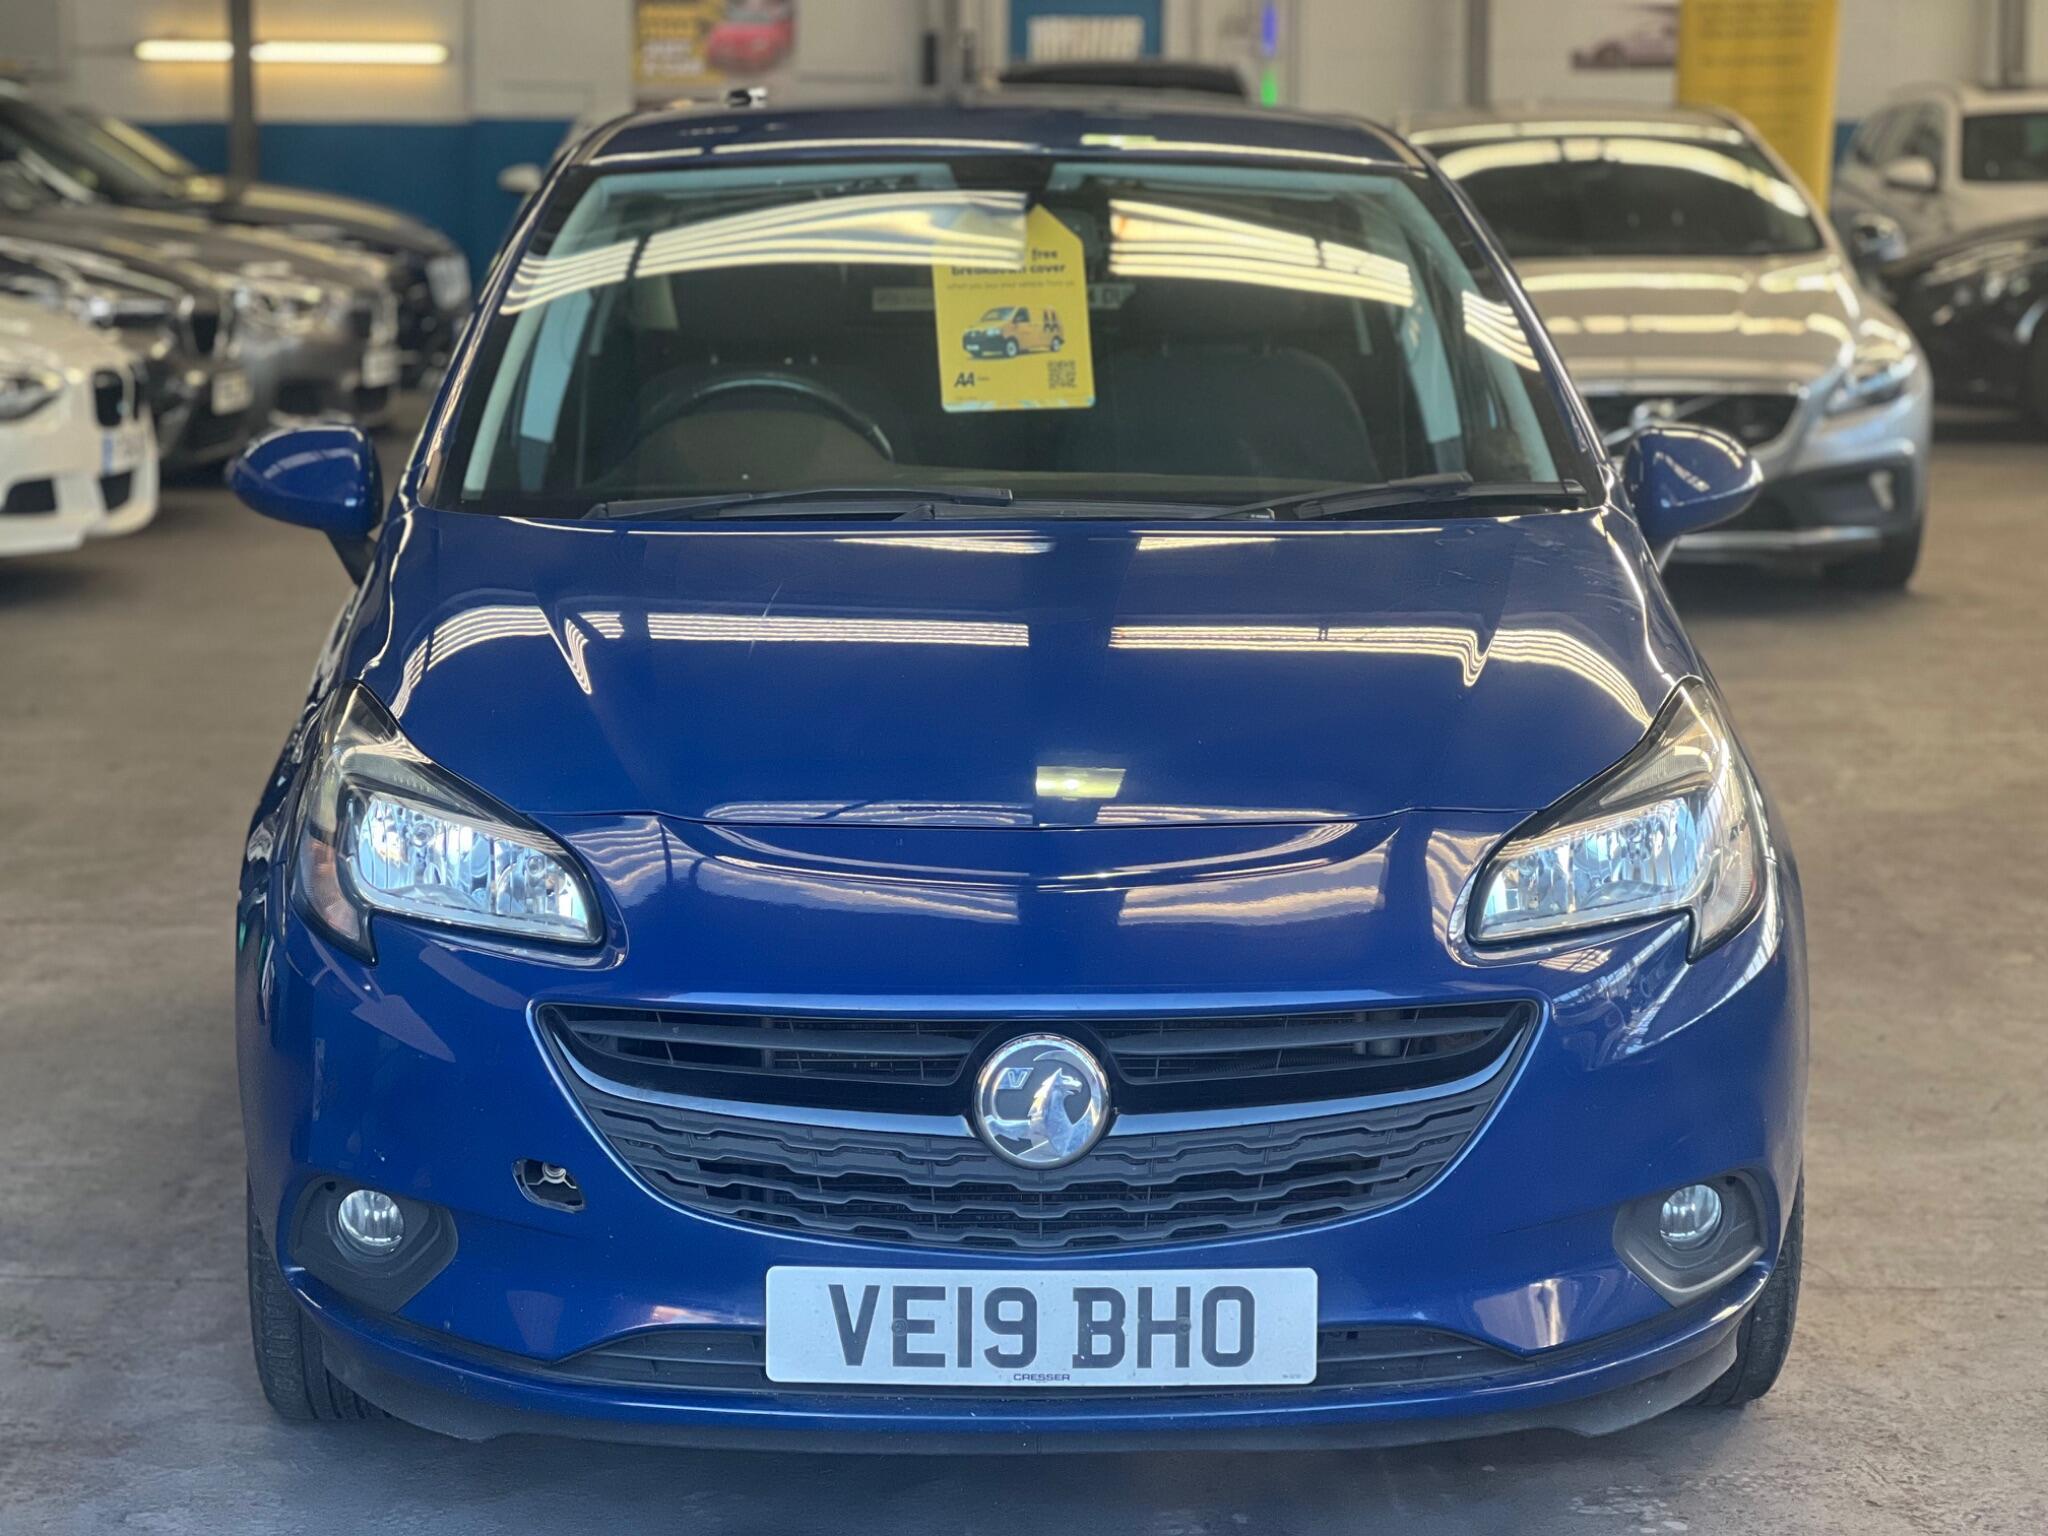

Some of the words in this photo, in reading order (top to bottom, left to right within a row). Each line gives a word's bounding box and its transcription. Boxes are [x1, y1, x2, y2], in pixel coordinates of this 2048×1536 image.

[1031, 247, 1059, 261] free
[1030, 264, 1066, 276] cover
[954, 371, 976, 388] AA
[828, 1284, 1038, 1368] VE19
[1072, 1286, 1256, 1369] BHO
